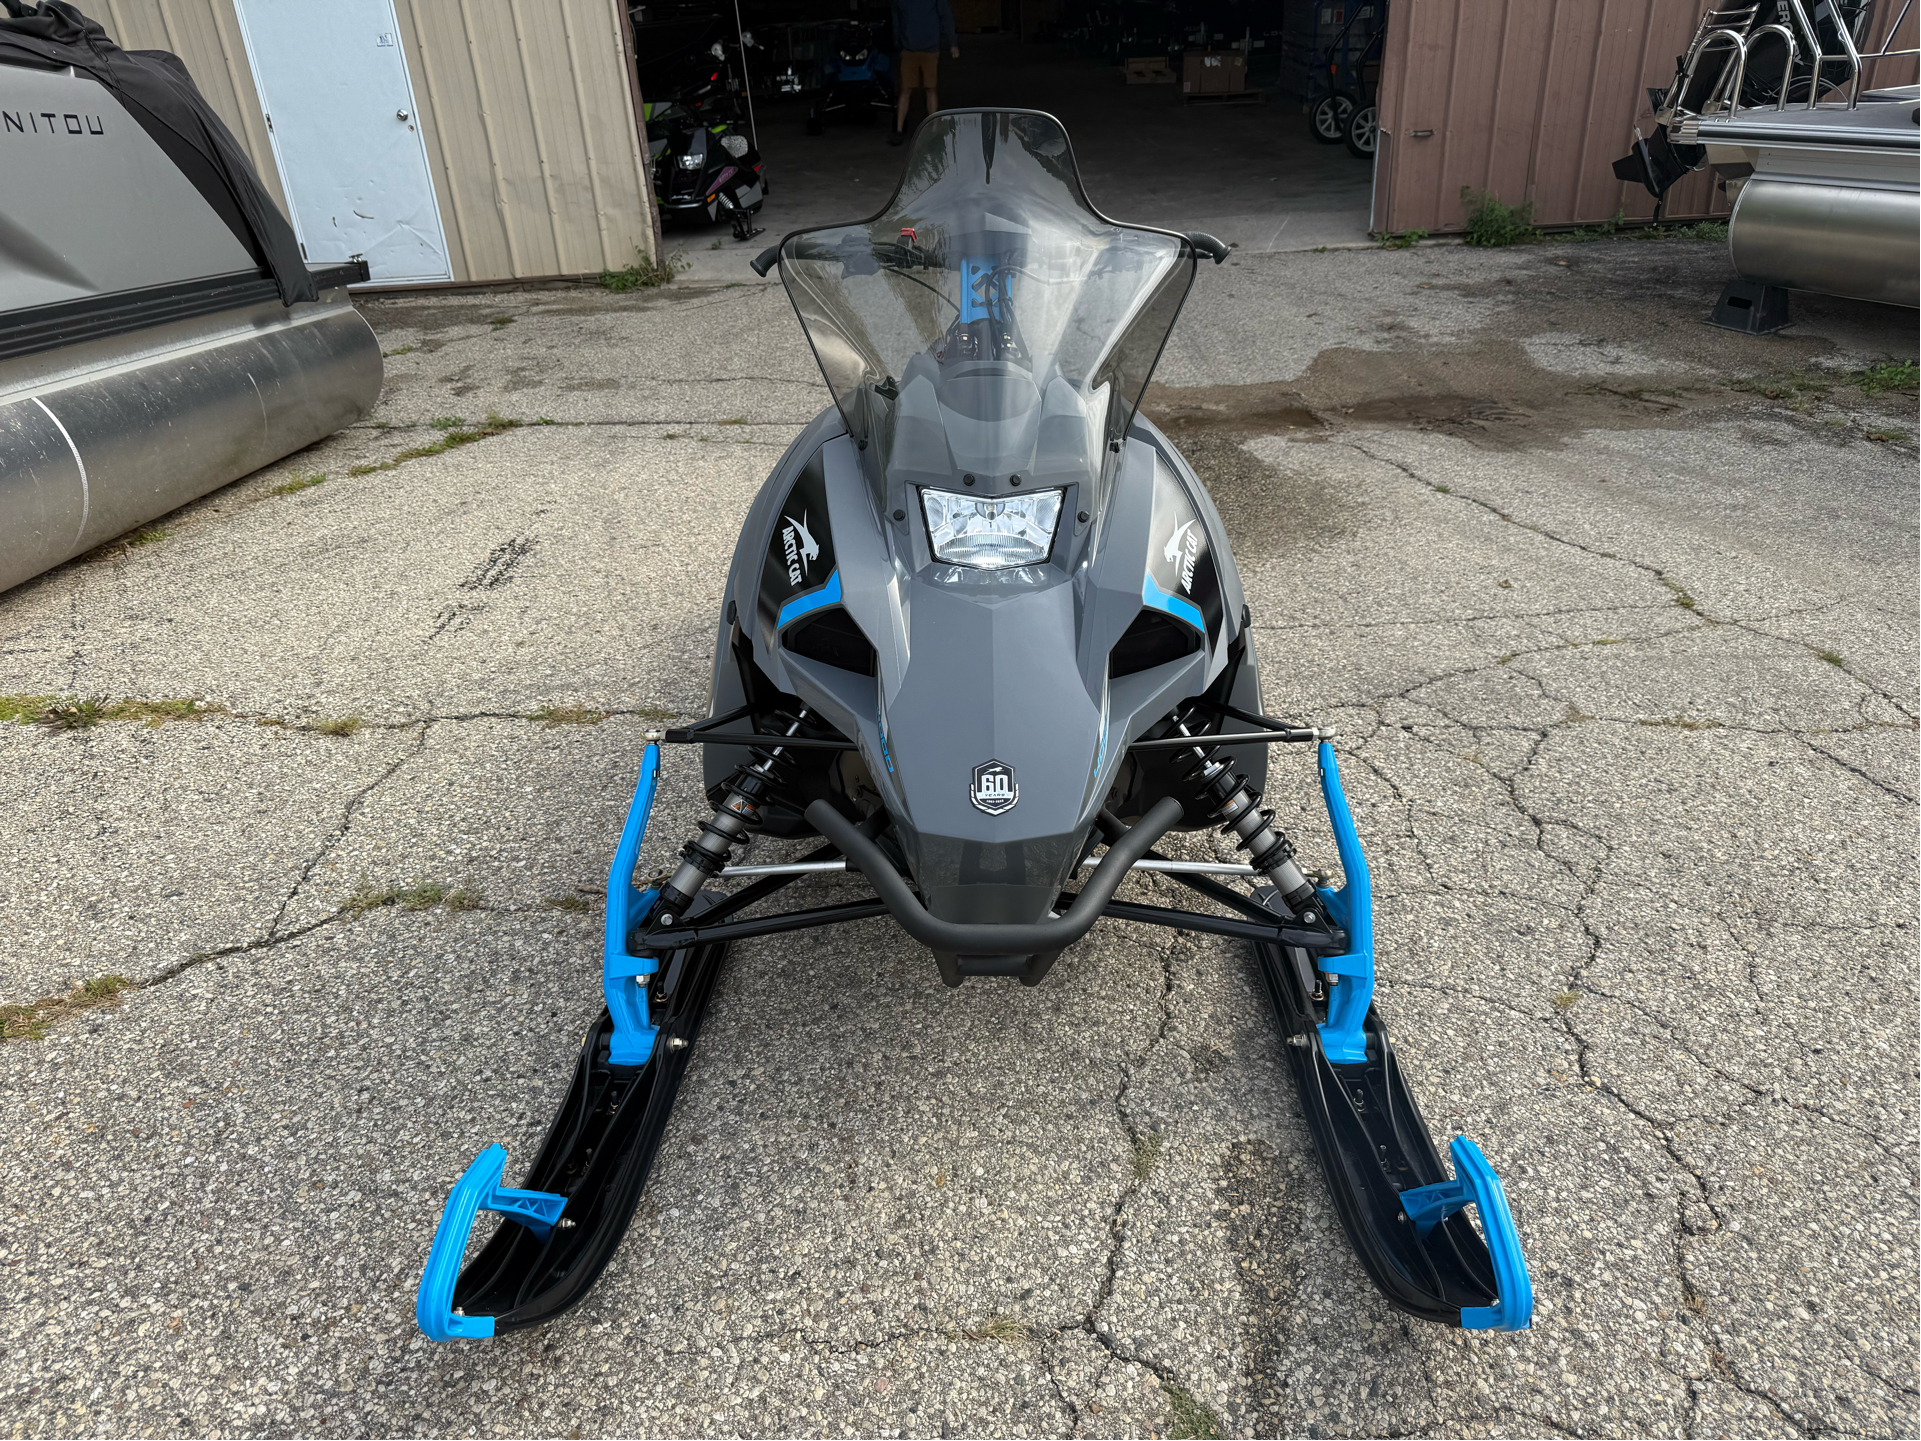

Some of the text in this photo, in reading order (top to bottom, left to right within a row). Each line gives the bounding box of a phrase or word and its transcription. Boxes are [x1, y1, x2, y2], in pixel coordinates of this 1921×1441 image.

[782, 525, 803, 587] ARCTIC CAT
[1180, 528, 1198, 595] ARCTIC CAT
[981, 774, 1009, 793] 60
